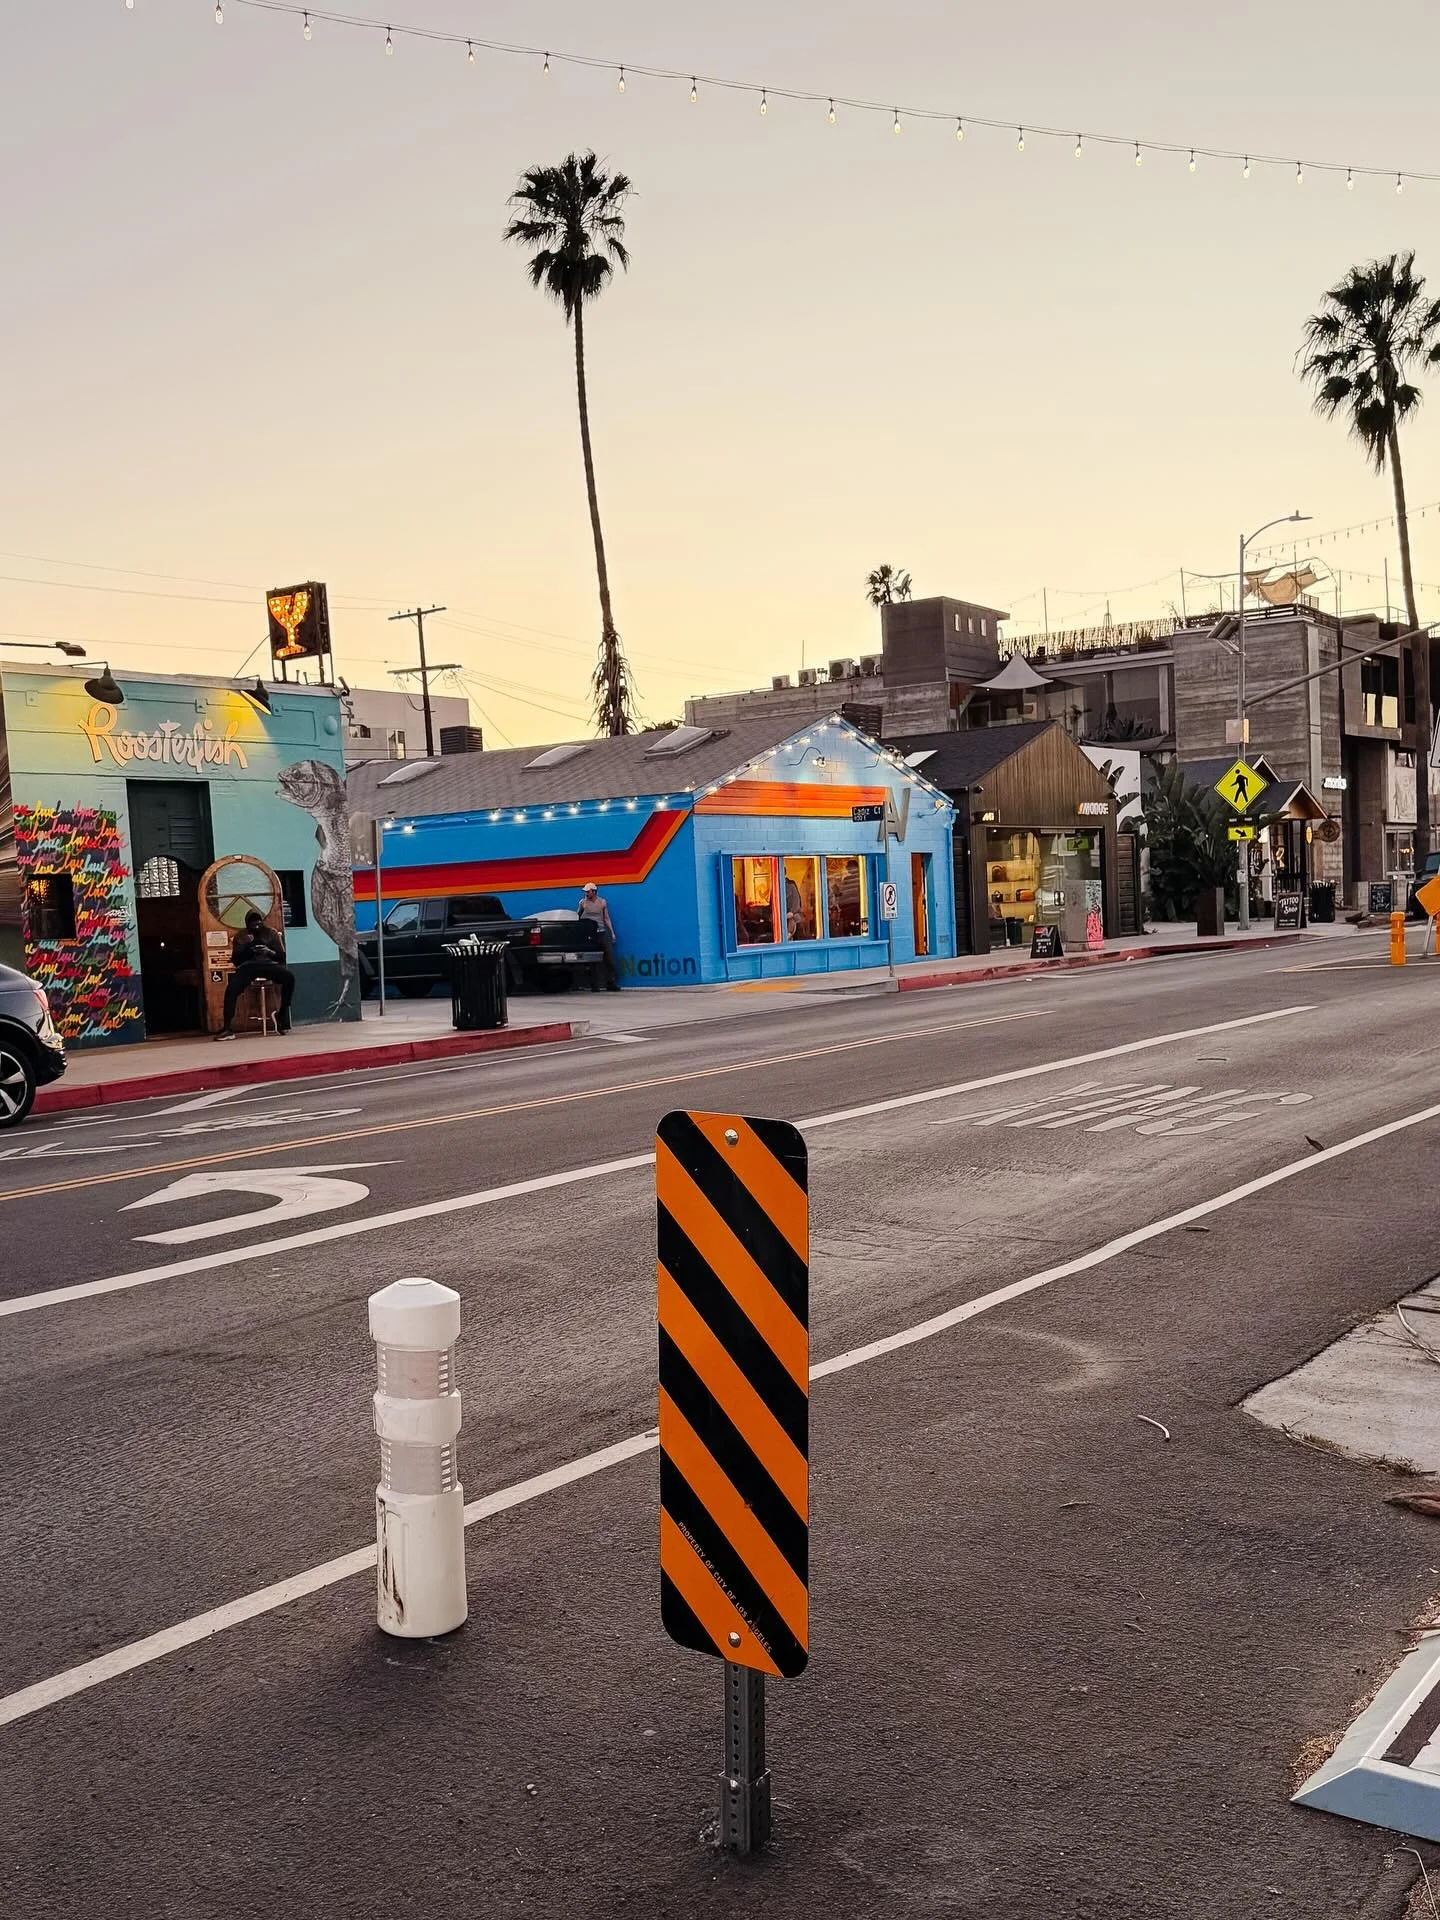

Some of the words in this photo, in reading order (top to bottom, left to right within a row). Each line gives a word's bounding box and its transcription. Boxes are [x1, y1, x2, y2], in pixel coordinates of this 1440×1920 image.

[77, 701, 249, 774] Roosterfish
[620, 953, 697, 977] Nation
[678, 1521, 706, 1558] PROPERTY
[705, 1559, 715, 1571] OF
[713, 1571, 728, 1588] CITY
[726, 1589, 737, 1602] OF
[735, 1602, 748, 1618] LOS
[747, 1619, 773, 1654] ANGELES
